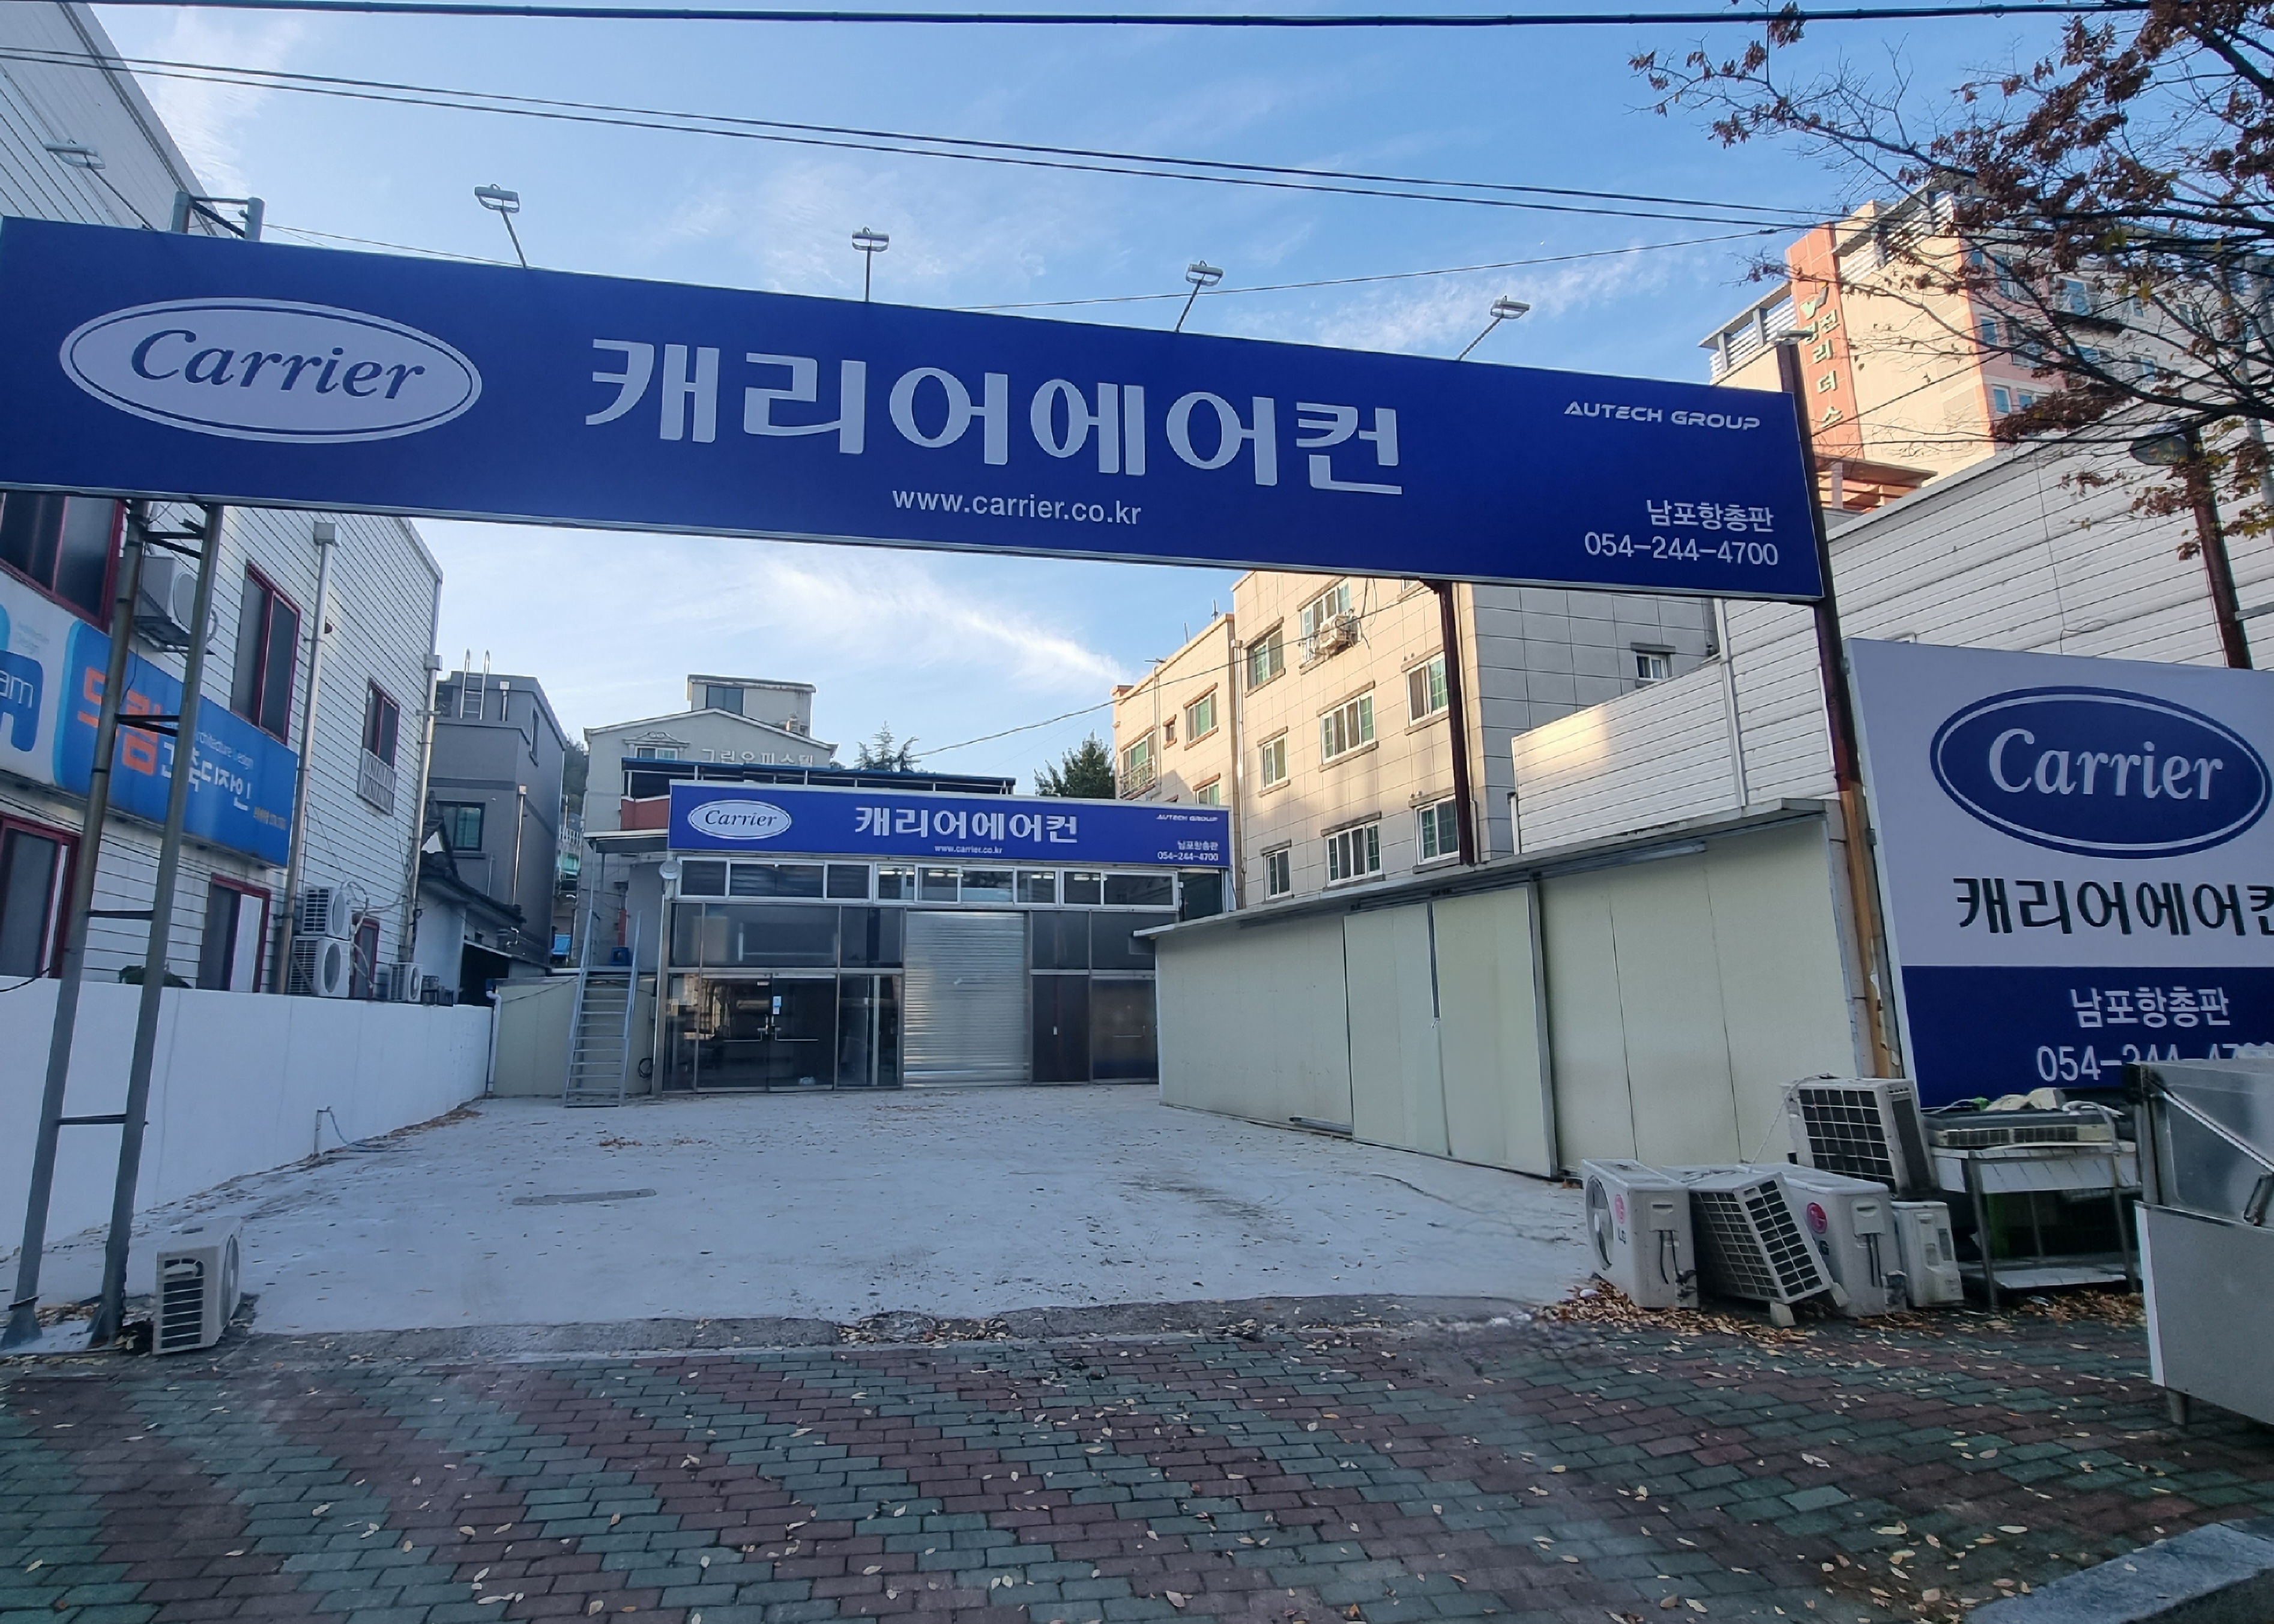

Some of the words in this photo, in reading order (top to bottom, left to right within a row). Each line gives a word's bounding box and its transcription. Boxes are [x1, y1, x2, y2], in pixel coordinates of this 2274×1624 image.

[130, 329, 424, 399] Carrier
[585, 338, 1403, 495] 캐리어에어컨
[1564, 401, 1663, 423] AUTECH
[1671, 410, 1760, 430] GROUP
[891, 489, 1142, 525] www.carrier.co.kr
[1647, 499, 1775, 532] 남포항총판
[1584, 531, 1779, 566] 054-244-4700
[1988, 727, 2224, 800] Carrier
[704, 810, 778, 828] Carrier
[855, 807, 1078, 844] 캐리어에어컨
[934, 845, 1003, 854] www.carrier.co.kr
[2069, 987, 2231, 1028] 남포항총판
